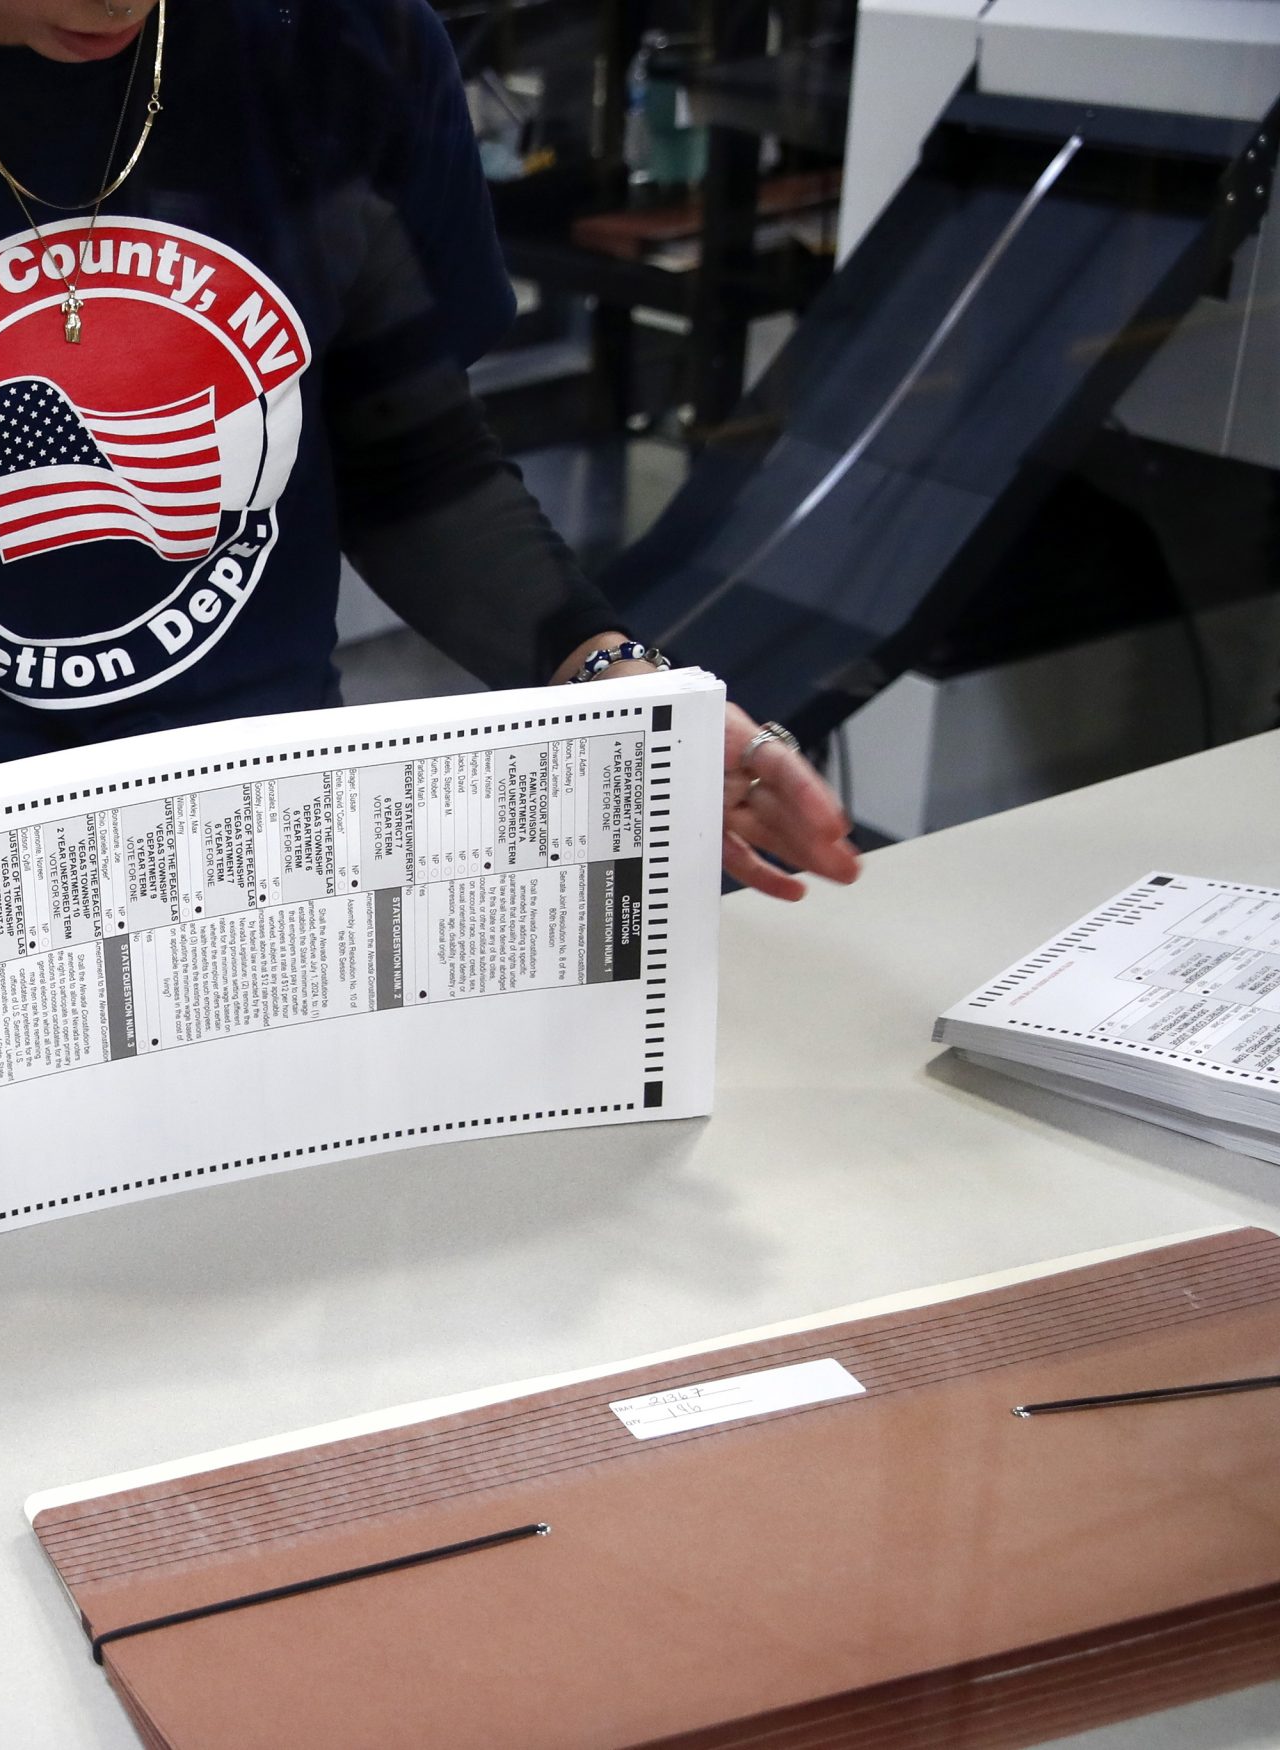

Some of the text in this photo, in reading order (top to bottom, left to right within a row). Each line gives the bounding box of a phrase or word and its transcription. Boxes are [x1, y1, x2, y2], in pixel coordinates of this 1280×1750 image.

[227, 291, 297, 377] NV
[148, 523, 268, 656] Dept.
[403, 763, 412, 800] REGENT
[507, 760, 516, 786] YEAR
[613, 747, 622, 773] YEAR
[383, 803, 392, 829] YEAR
[497, 777, 506, 844] VOTE FOR ONE
[507, 787, 516, 839] UNEXPIRED
[518, 773, 527, 843] DEPARTMENT A
[528, 770, 537, 843] FAMILY DIVISION
[538, 751, 548, 857] DISTRICT COURT JUDGE
[601, 764, 611, 831] VOTE FOR ONE
[612, 774, 621, 826] UNEXPIRED
[622, 759, 632, 831] DEPARTMENT 17
[632, 740, 644, 848] DISTRICT COURT JUDGE
[281, 806, 293, 874] VOTE FOR ONE
[293, 816, 302, 842] YEAR
[302, 803, 313, 864] DEPARTMENT
[312, 795, 323, 876] VEGAS TOWNSHIP
[322, 771, 334, 894] JUSTICE OF THE PEACE LAS
[372, 794, 383, 861] VOTE FOR ONE
[384, 830, 393, 856] TERM
[393, 801, 403, 841] DISTRICT
[551, 837, 559, 848] NP
[577, 834, 586, 846] NP
[612, 826, 621, 853] TERM
[293, 842, 303, 869] TERM
[337, 865, 346, 877] NP
[350, 864, 359, 875] NP
[404, 830, 413, 882] UNIVERSITY
[484, 846, 492, 857] NP
[507, 839, 516, 865] TERM
[0, 855, 14, 937] VEGAS TOWNSHIP
[7, 830, 26, 955] JUSTICE OF THE PEACE LAS
[620, 894, 630, 945] QUESTIONS
[631, 901, 641, 936] BALLOT
[603, 943, 613, 966] NUM.
[393, 969, 402, 992] NUM.
[125, 1017, 134, 1041] NUM.
